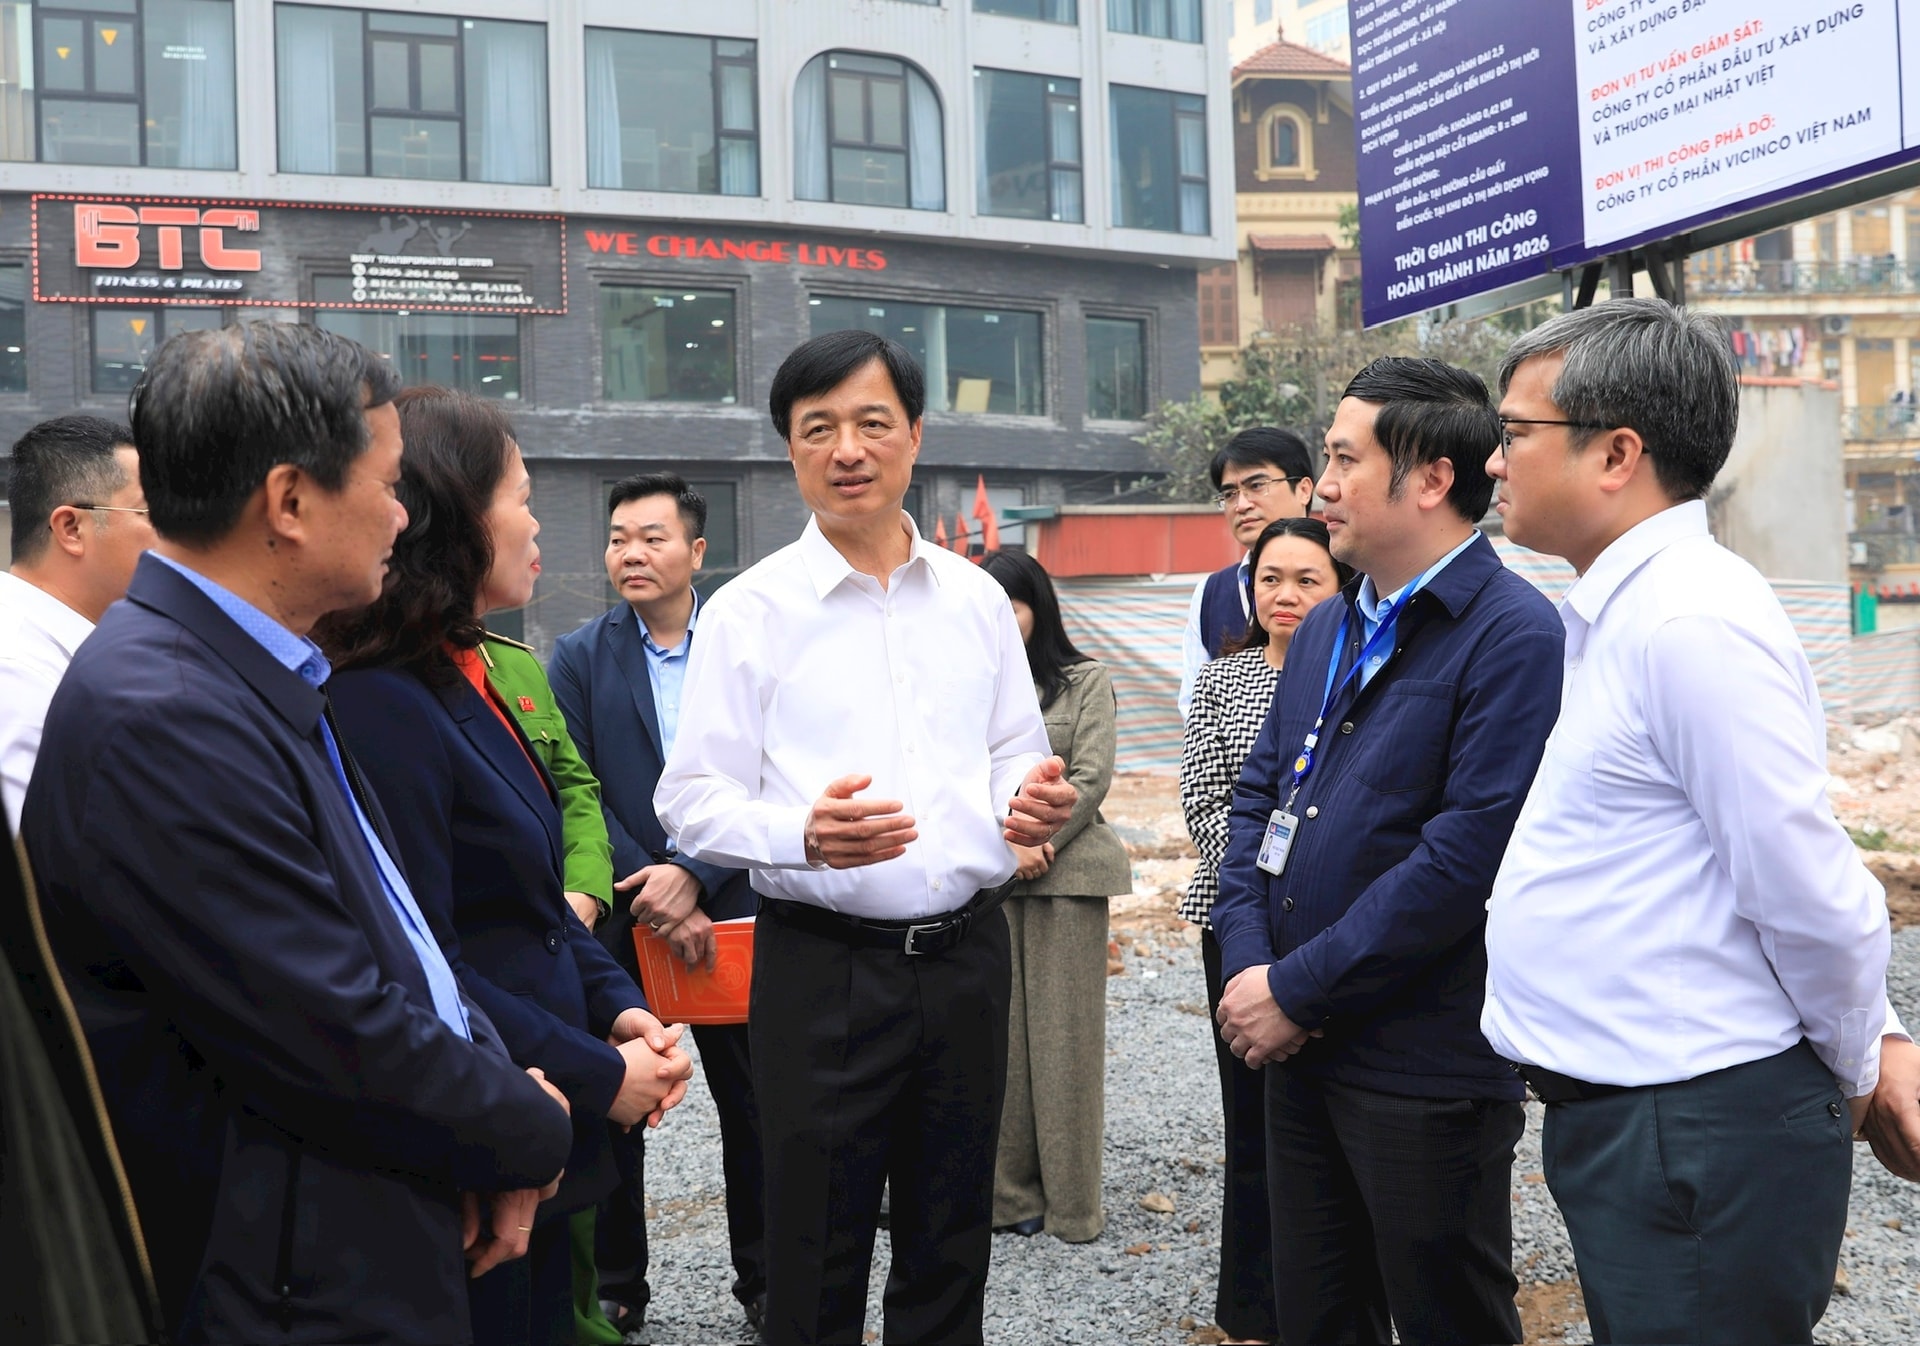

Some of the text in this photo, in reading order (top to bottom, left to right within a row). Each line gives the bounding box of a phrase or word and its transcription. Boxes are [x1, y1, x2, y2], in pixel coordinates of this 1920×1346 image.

[1587, 6, 1627, 32] CÔNG
[1589, 35, 1606, 54] VÀ
[1610, 24, 1637, 47] XÂY
[1640, 6, 1678, 32] DỰNG
[1591, 18, 1763, 101] ĐƠN VỊ TƯ VẤN GIÁM SÁT:
[1592, 3, 1864, 122] CÔNG TY CỔ PHẦN ĐẦU TƯ XÂY DỰNG
[1593, 64, 1775, 146] VÀ THƯƠNG MẠI NHẬT VIỆT
[1595, 113, 1776, 190] ĐƠN VỊ THI CÔNG PHÁ DỠ:
[1596, 106, 1872, 212] CÔNG TY CỔ PHẦN VICINCO VIỆT NAM
[74, 203, 262, 271] BTC
[584, 229, 888, 271] WE CHANGE LIVES
[1387, 233, 1550, 301] HOÀN THÀNH NĂM 2026
[1394, 208, 1538, 272] THỜI GIAN THI CÔNG
[95, 276, 244, 290] FITNESS & PILATES
